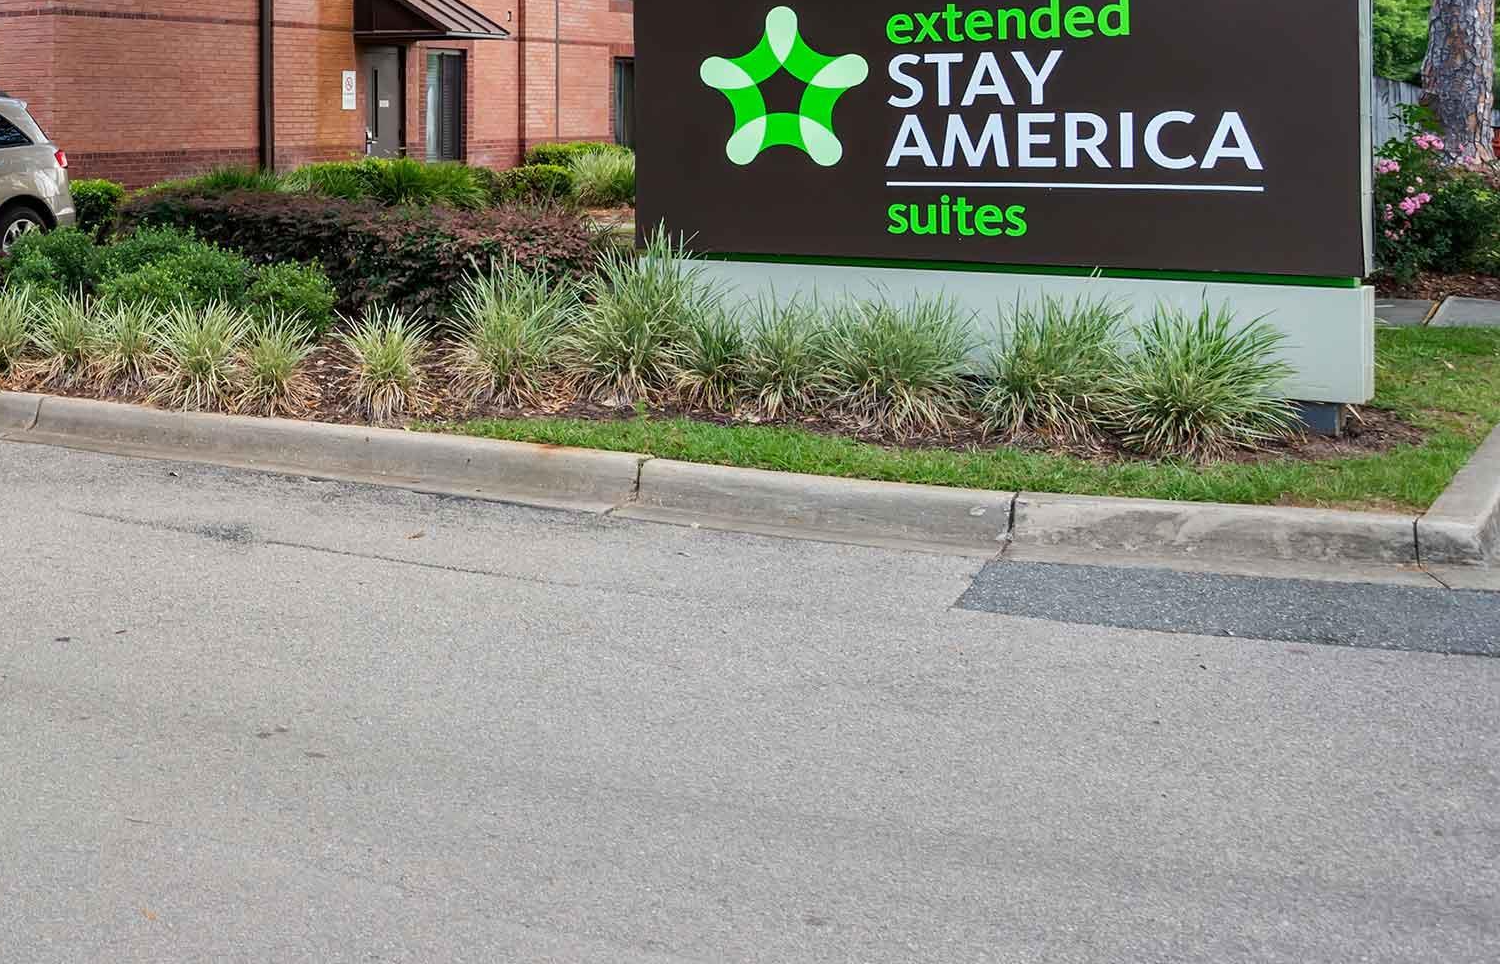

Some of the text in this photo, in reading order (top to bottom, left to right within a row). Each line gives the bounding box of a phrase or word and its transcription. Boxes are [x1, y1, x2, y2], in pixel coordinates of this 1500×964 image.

[887, 50, 1063, 107] STAY
[886, 111, 1263, 170] AMERICA
[887, 195, 1028, 236] suites
